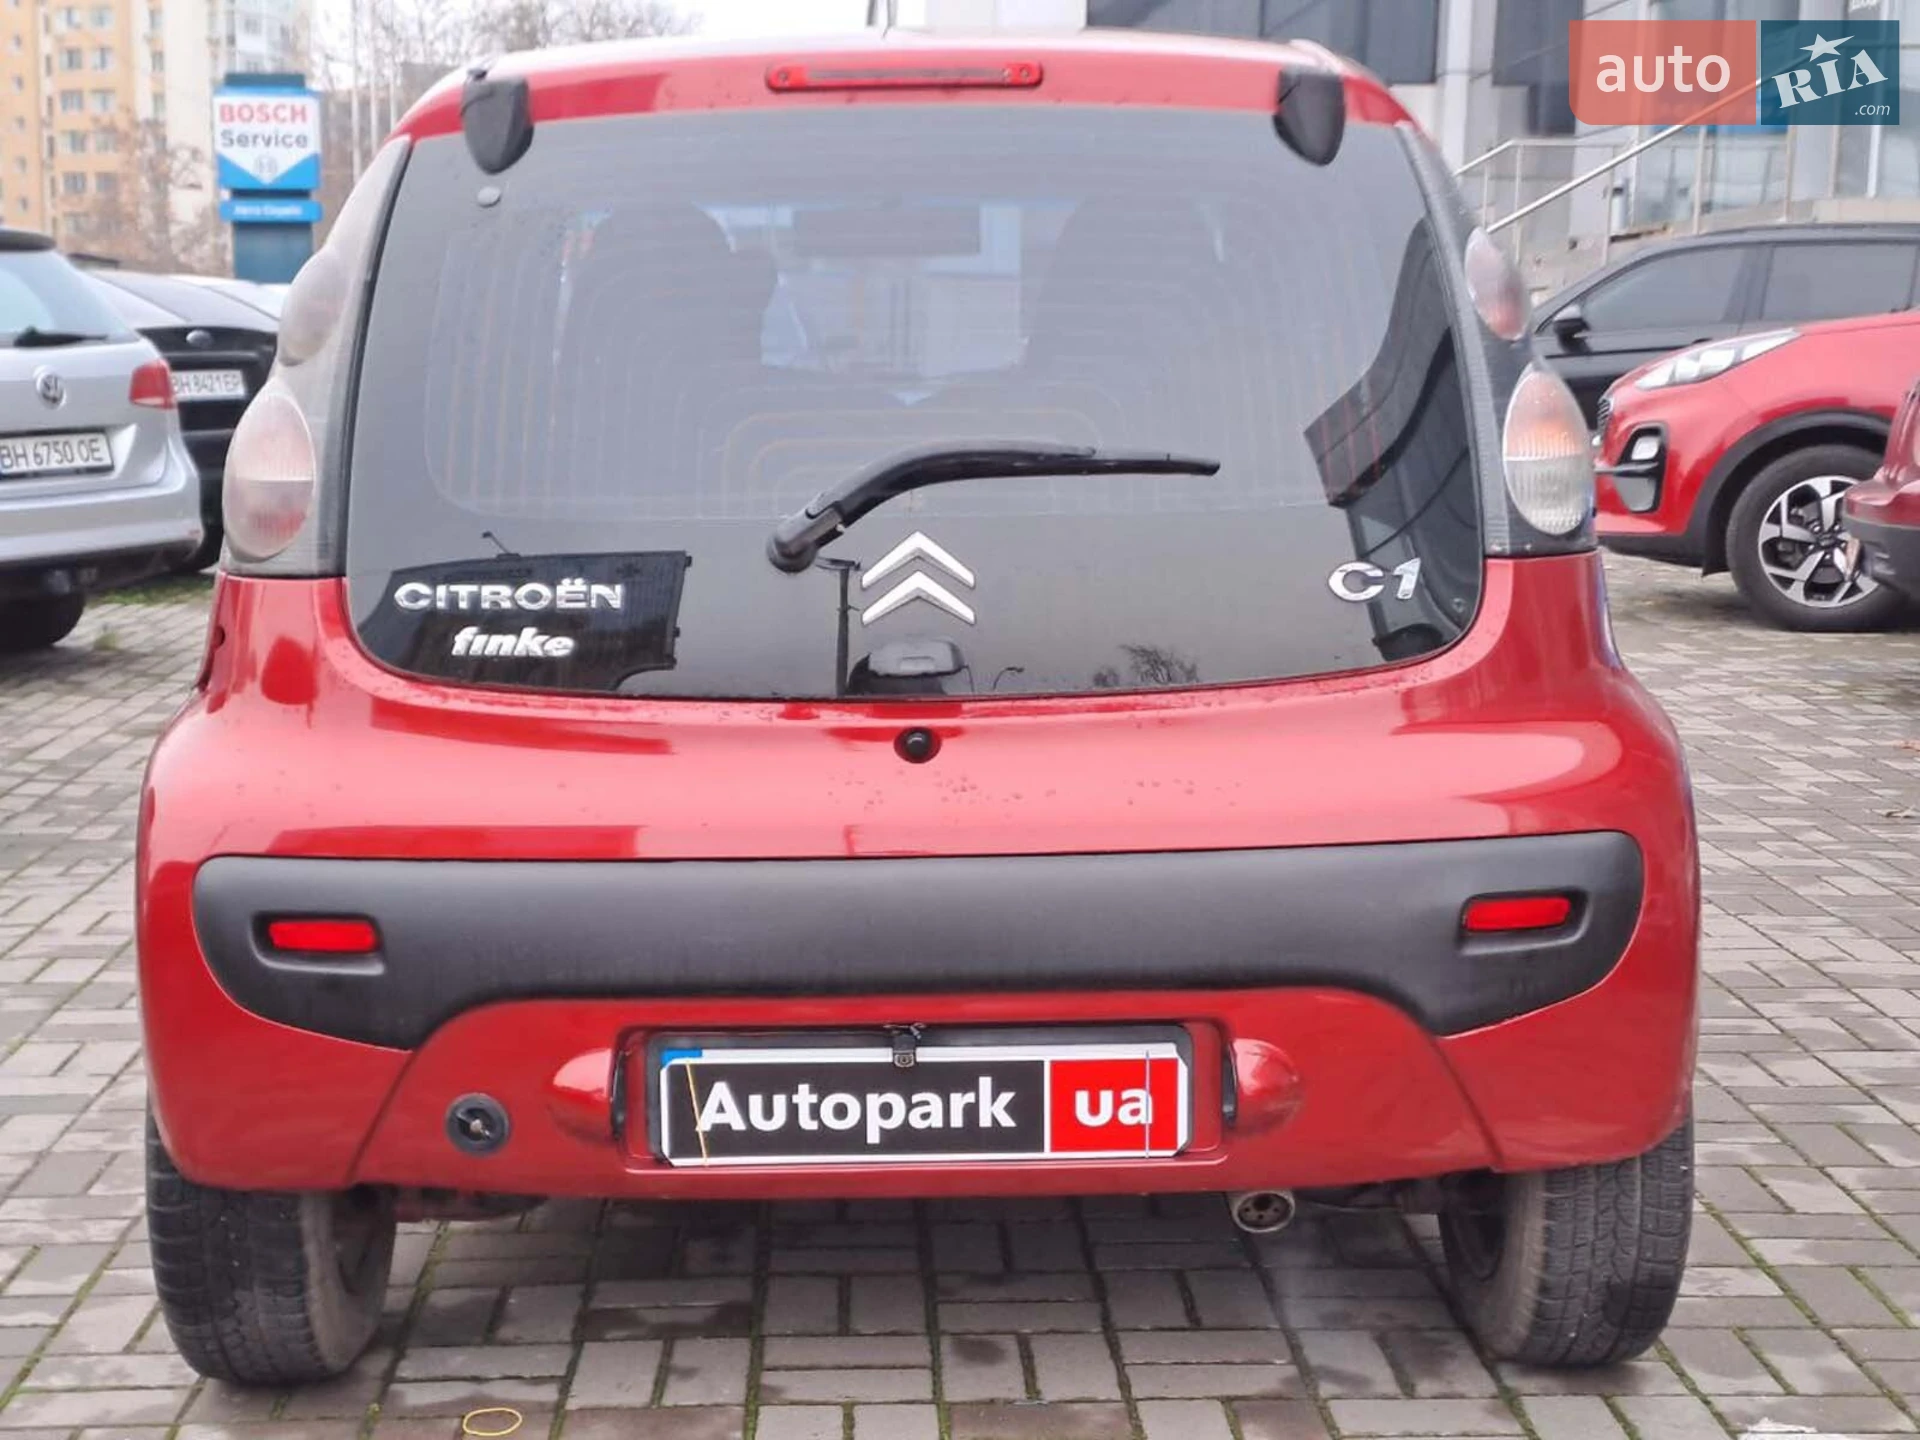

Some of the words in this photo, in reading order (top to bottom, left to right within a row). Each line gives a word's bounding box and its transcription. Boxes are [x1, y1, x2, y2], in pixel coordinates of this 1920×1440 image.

[219, 103, 307, 124] BOSCH
[220, 128, 308, 149] Service
[0, 443, 29, 469] BH
[33, 440, 74, 466] 6750
[77, 437, 103, 463] OE
[394, 578, 626, 611] CITROËN
[1328, 557, 1422, 603] C1
[451, 625, 575, 658] finke
[699, 1076, 1018, 1145] Autopark
[1073, 1086, 1153, 1128] ua
